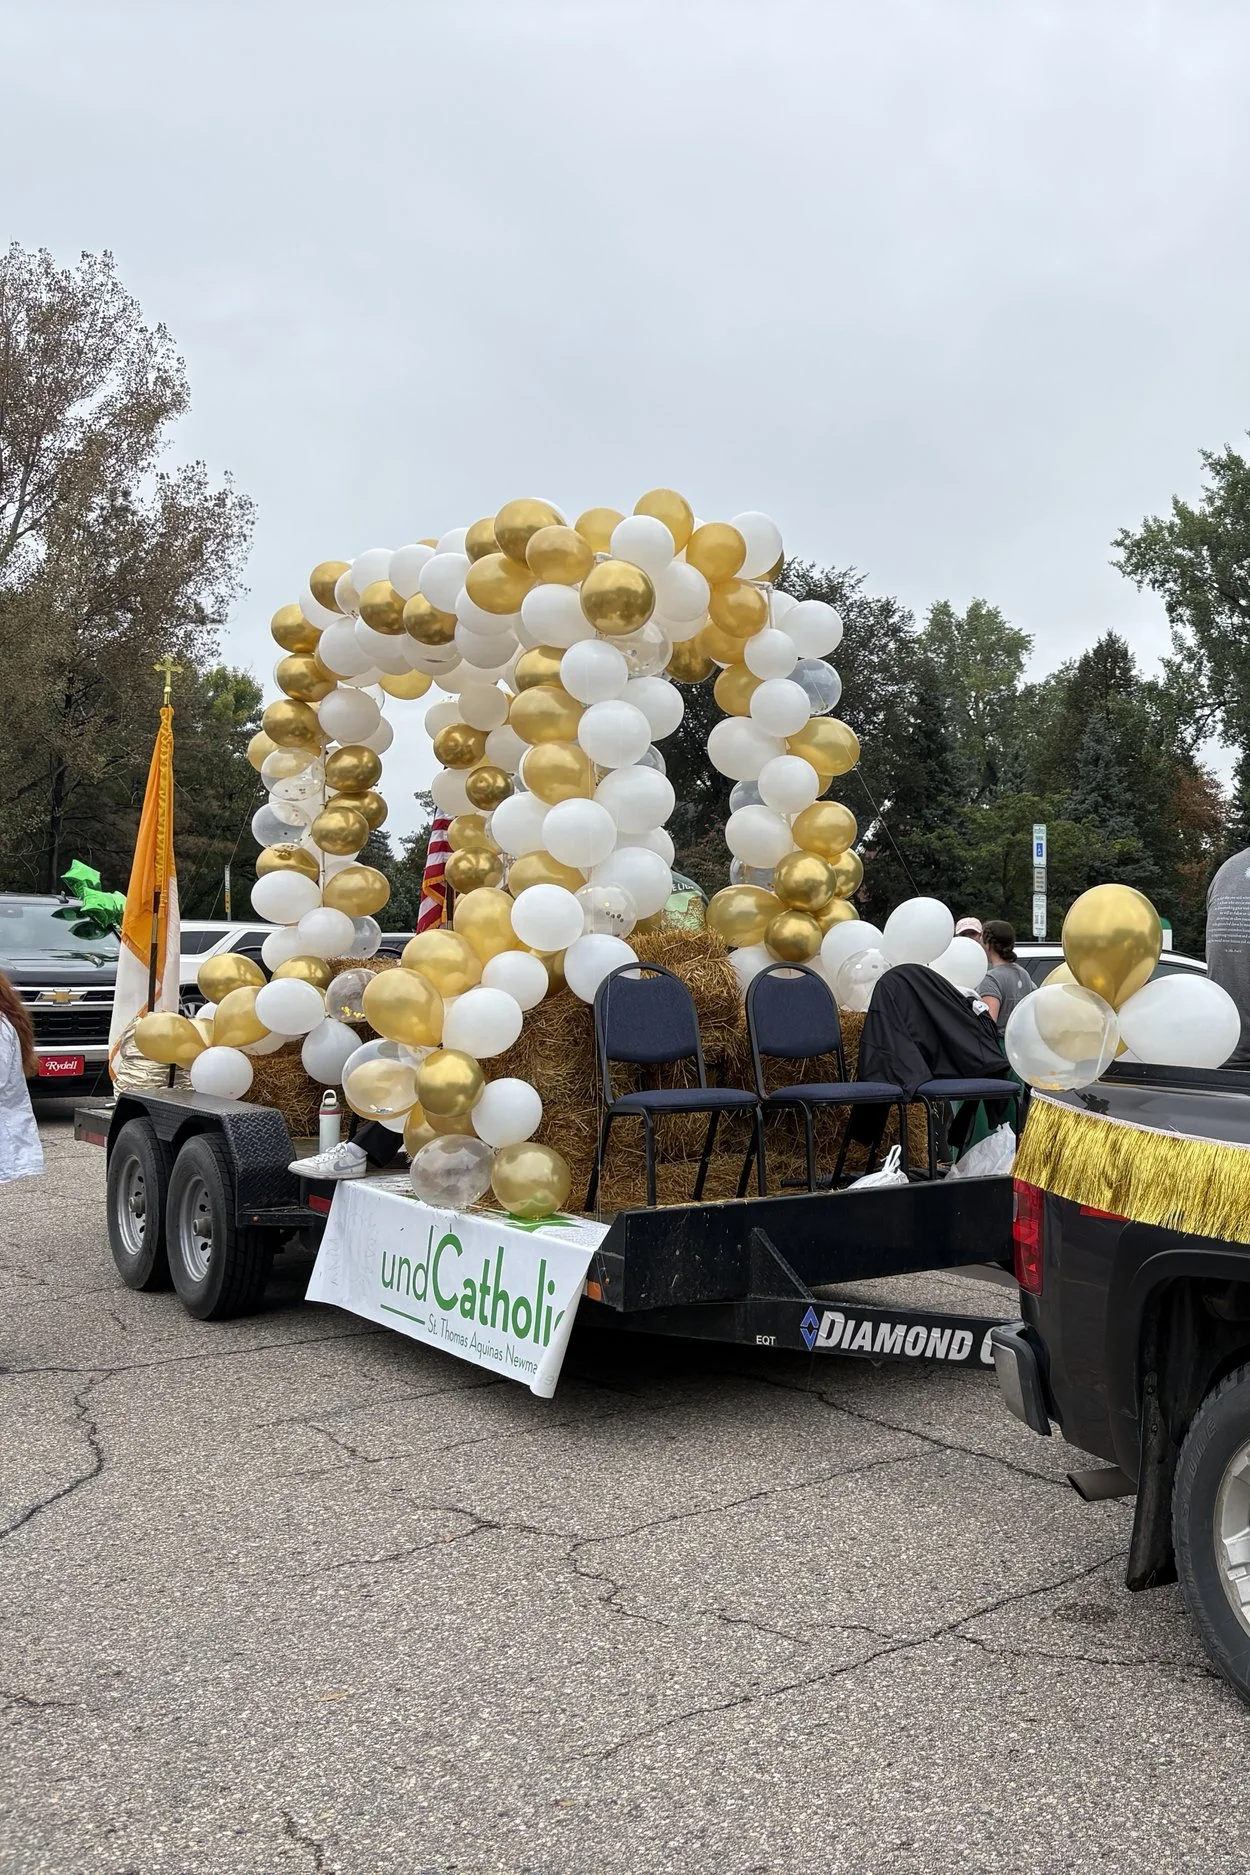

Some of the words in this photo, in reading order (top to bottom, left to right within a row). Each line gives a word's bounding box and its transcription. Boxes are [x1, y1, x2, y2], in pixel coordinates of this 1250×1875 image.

[45, 1061, 77, 1071] Rydell
[428, 1313, 438, 1335] St.
[440, 1317, 468, 1348] Thomas
[469, 1331, 503, 1361] Aquinas
[505, 1343, 538, 1375] Newma
[756, 1335, 776, 1346] EQT
[815, 1310, 973, 1361] DIAMOND
